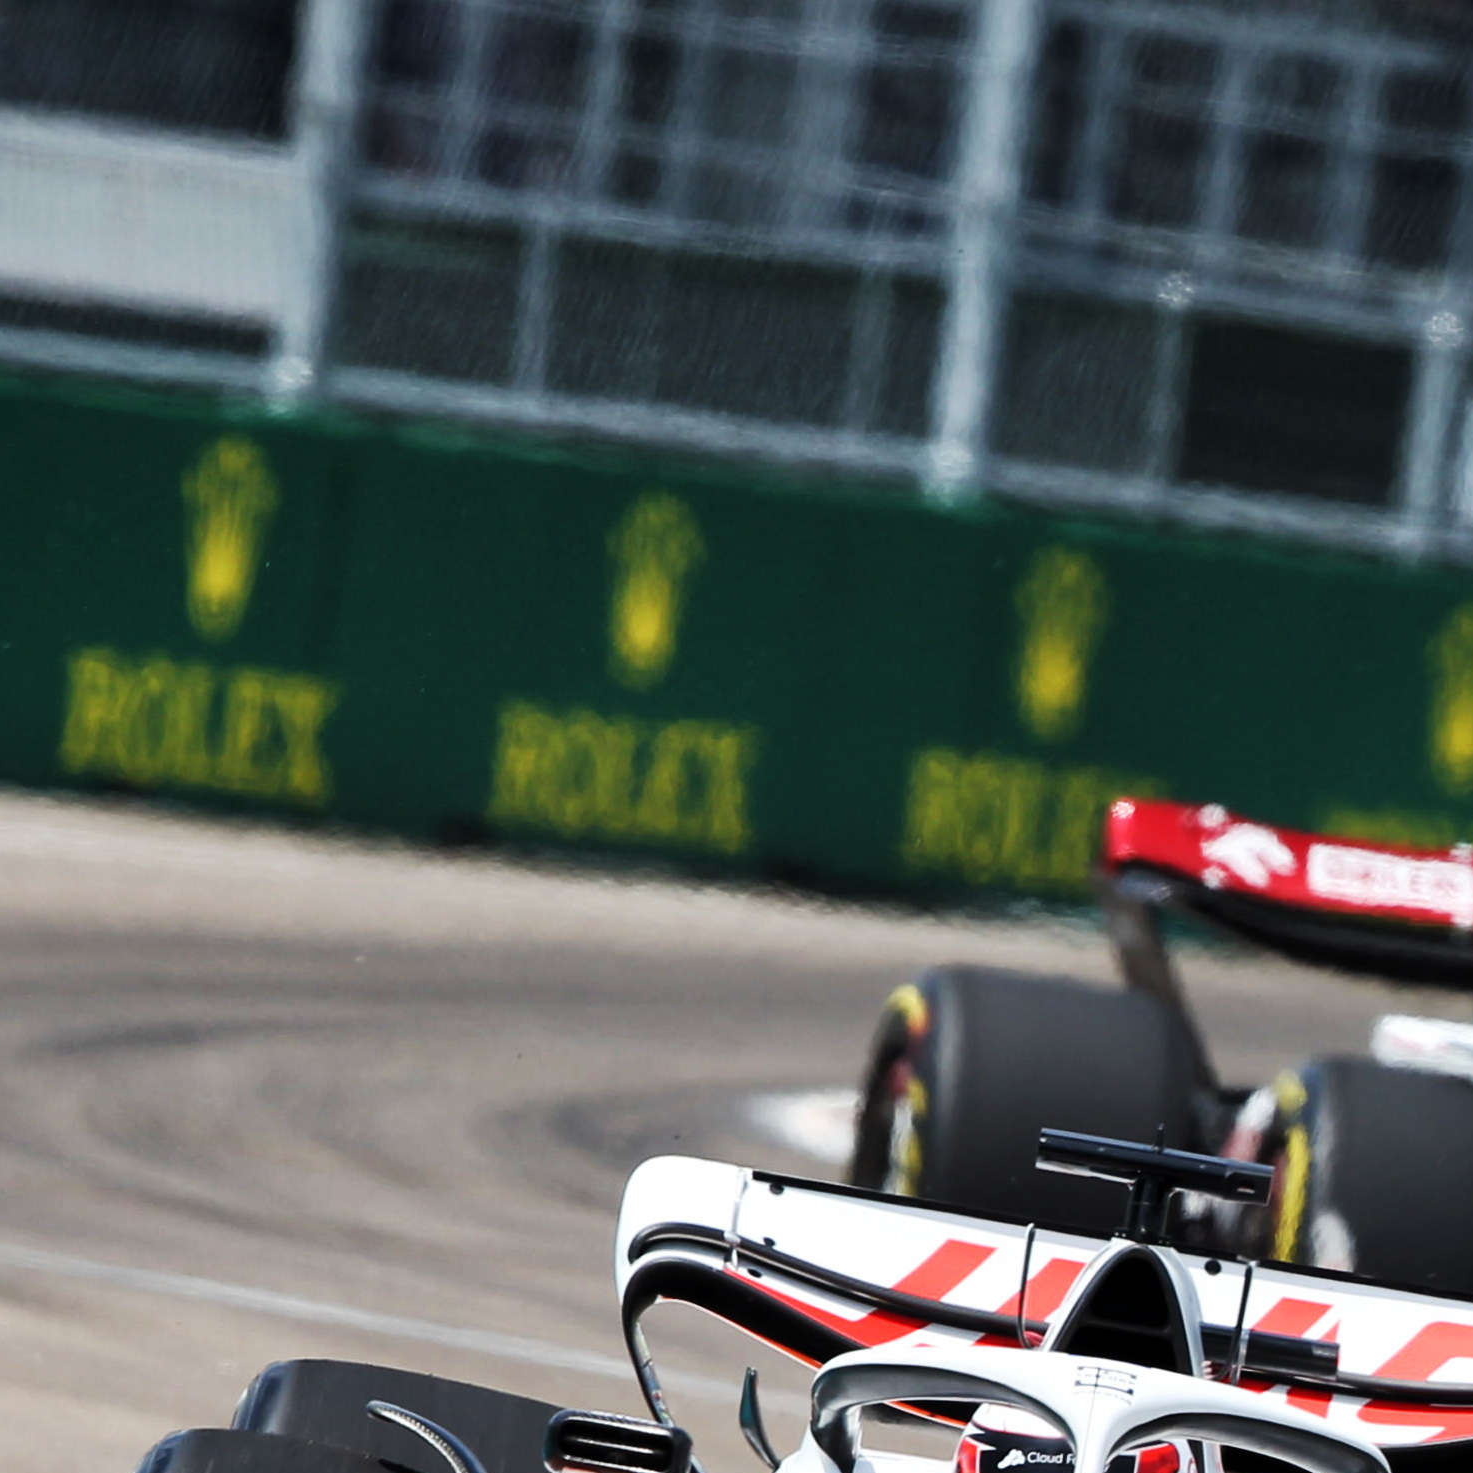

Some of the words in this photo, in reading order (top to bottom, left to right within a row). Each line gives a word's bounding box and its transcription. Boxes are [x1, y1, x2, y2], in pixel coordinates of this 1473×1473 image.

[59, 647, 331, 801] ROLEX
[492, 702, 751, 854] ROLEX
[1027, 1451, 1063, 1464] Cloud
